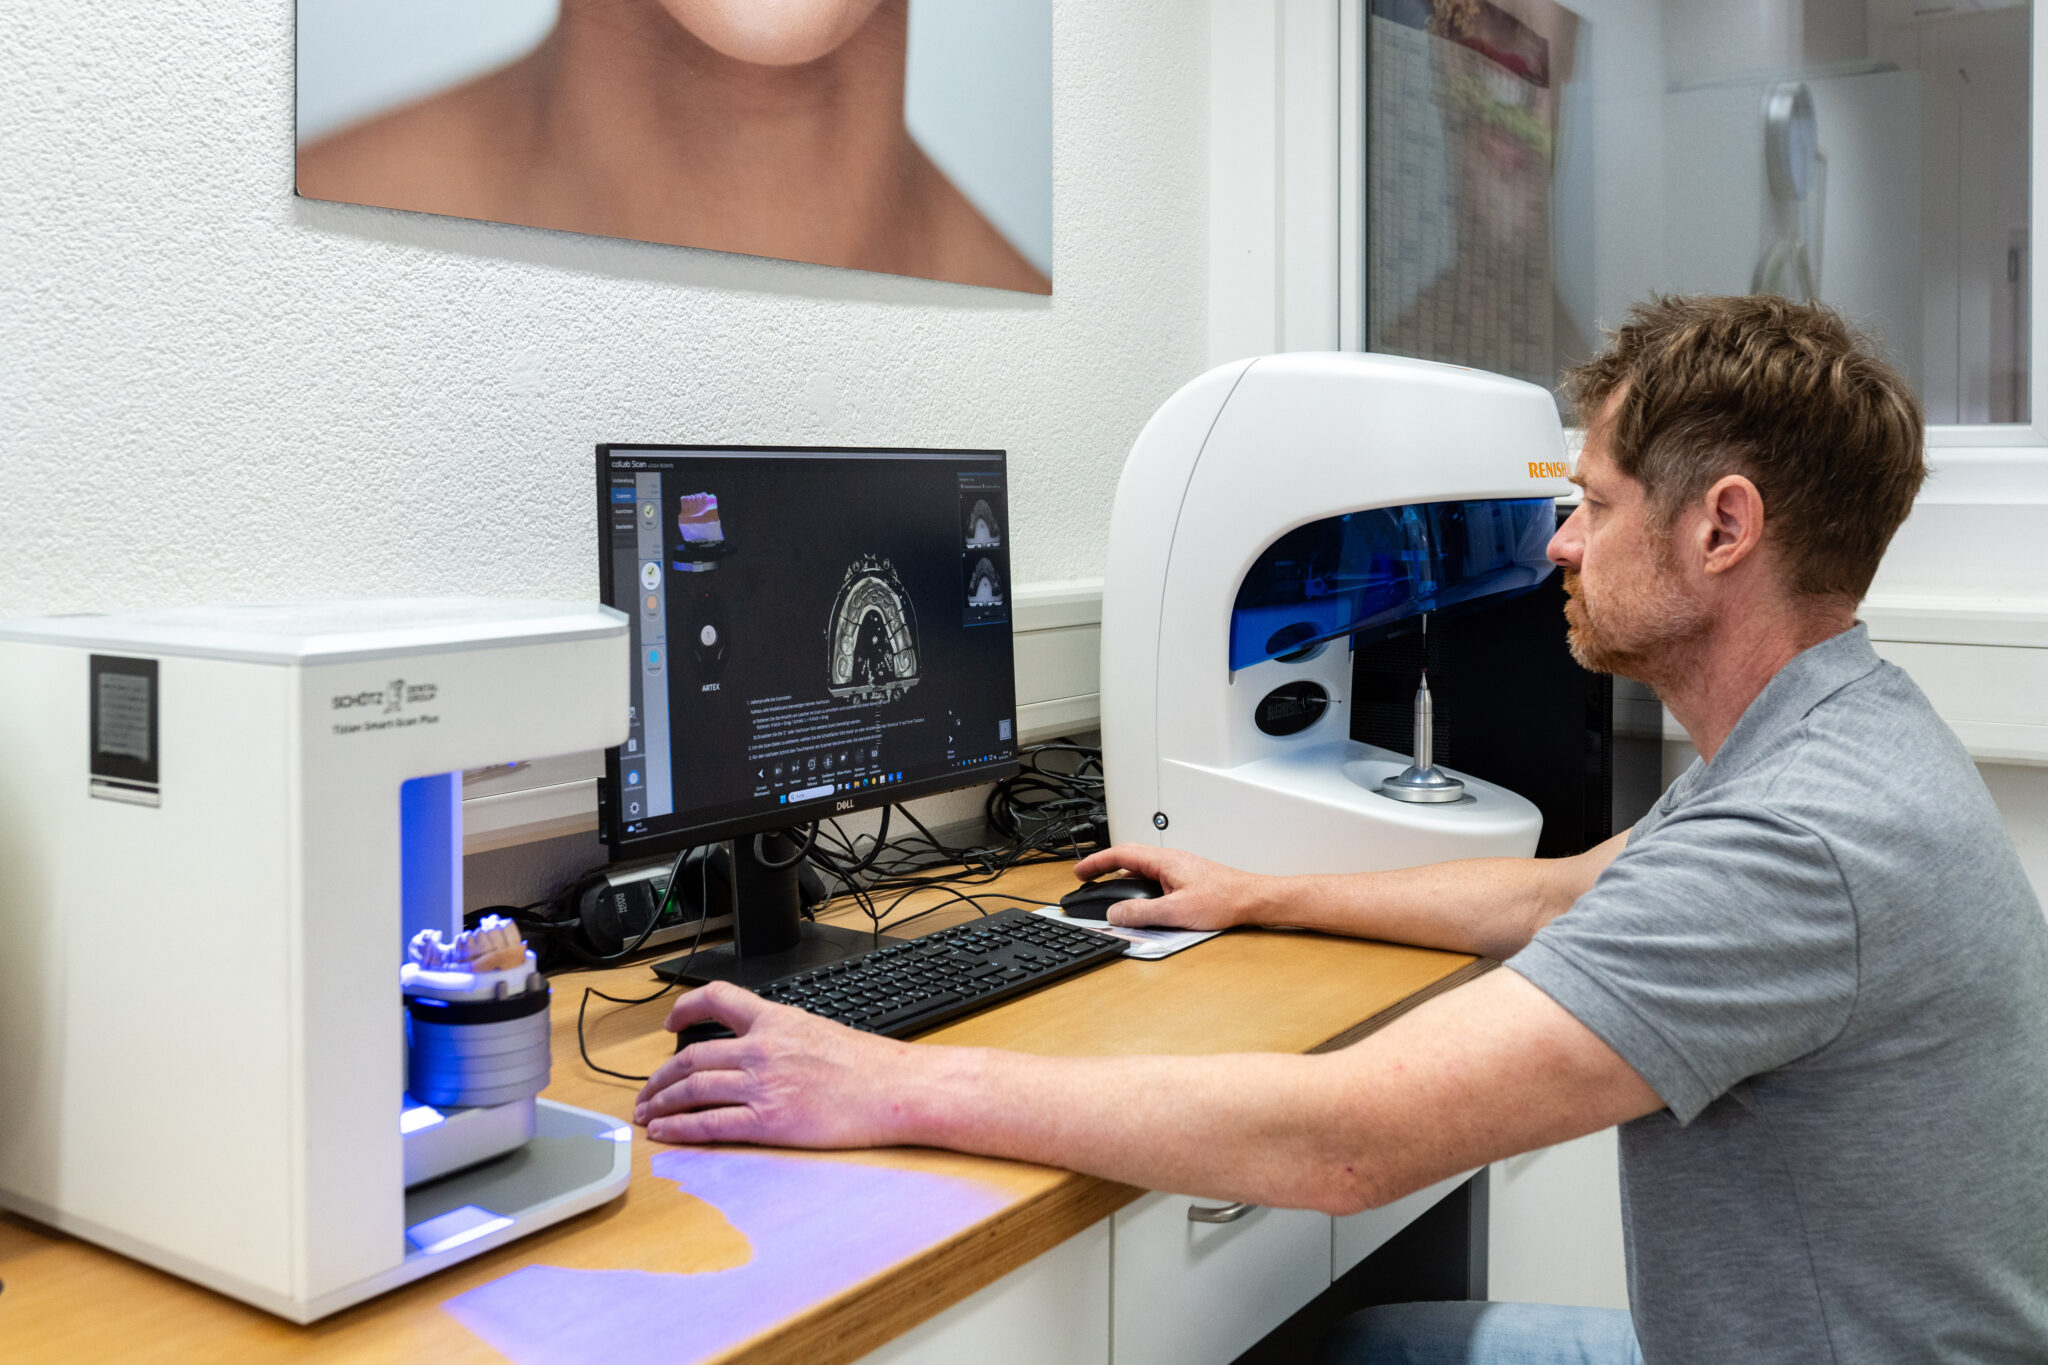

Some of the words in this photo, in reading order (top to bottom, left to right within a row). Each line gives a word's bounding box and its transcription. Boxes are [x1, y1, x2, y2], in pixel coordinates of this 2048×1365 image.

[632, 460, 647, 468] Scan
[701, 683, 721, 692] ARTEX
[836, 800, 855, 811] DELL
